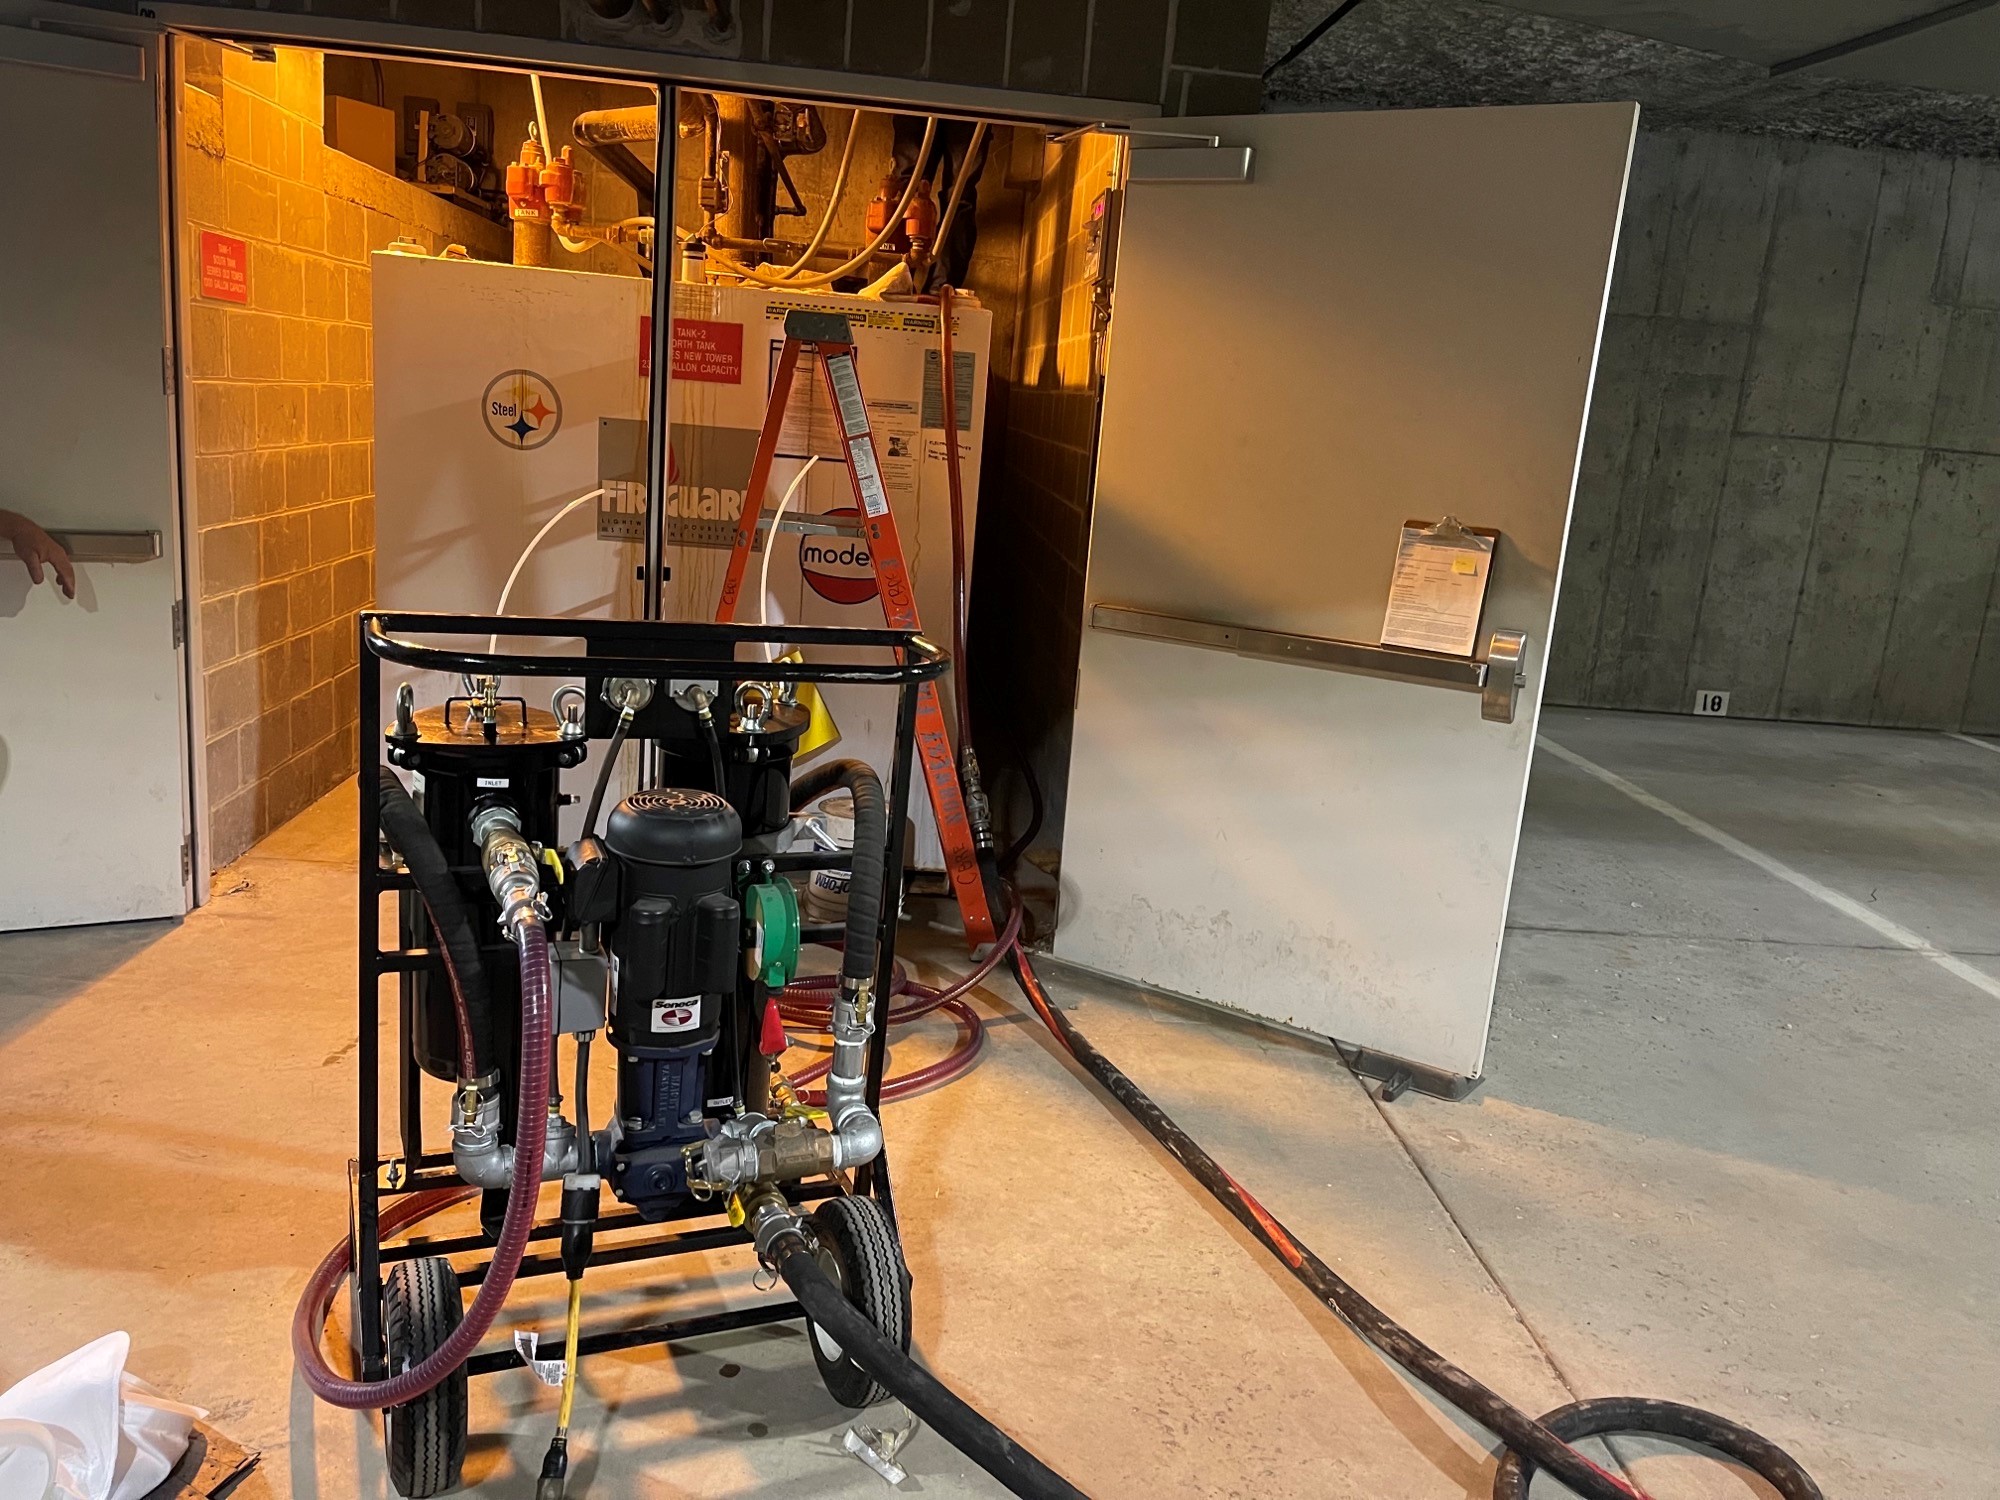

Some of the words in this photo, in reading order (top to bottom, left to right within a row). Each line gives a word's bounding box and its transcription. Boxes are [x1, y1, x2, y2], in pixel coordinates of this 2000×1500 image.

[904, 319, 933, 328] WARNING
[677, 327, 706, 339] TANK-2
[672, 338, 693, 349] ORTH
[696, 341, 716, 350] TANK
[684, 351, 702, 361] NEW
[705, 353, 733, 363] TOWER
[700, 364, 739, 375] CAPACITY
[492, 402, 516, 417] Steel
[804, 543, 871, 568] mode
[1702, 694, 1722, 712] 18
[953, 843, 977, 885] CBRE
[654, 999, 698, 1009] Seneca
